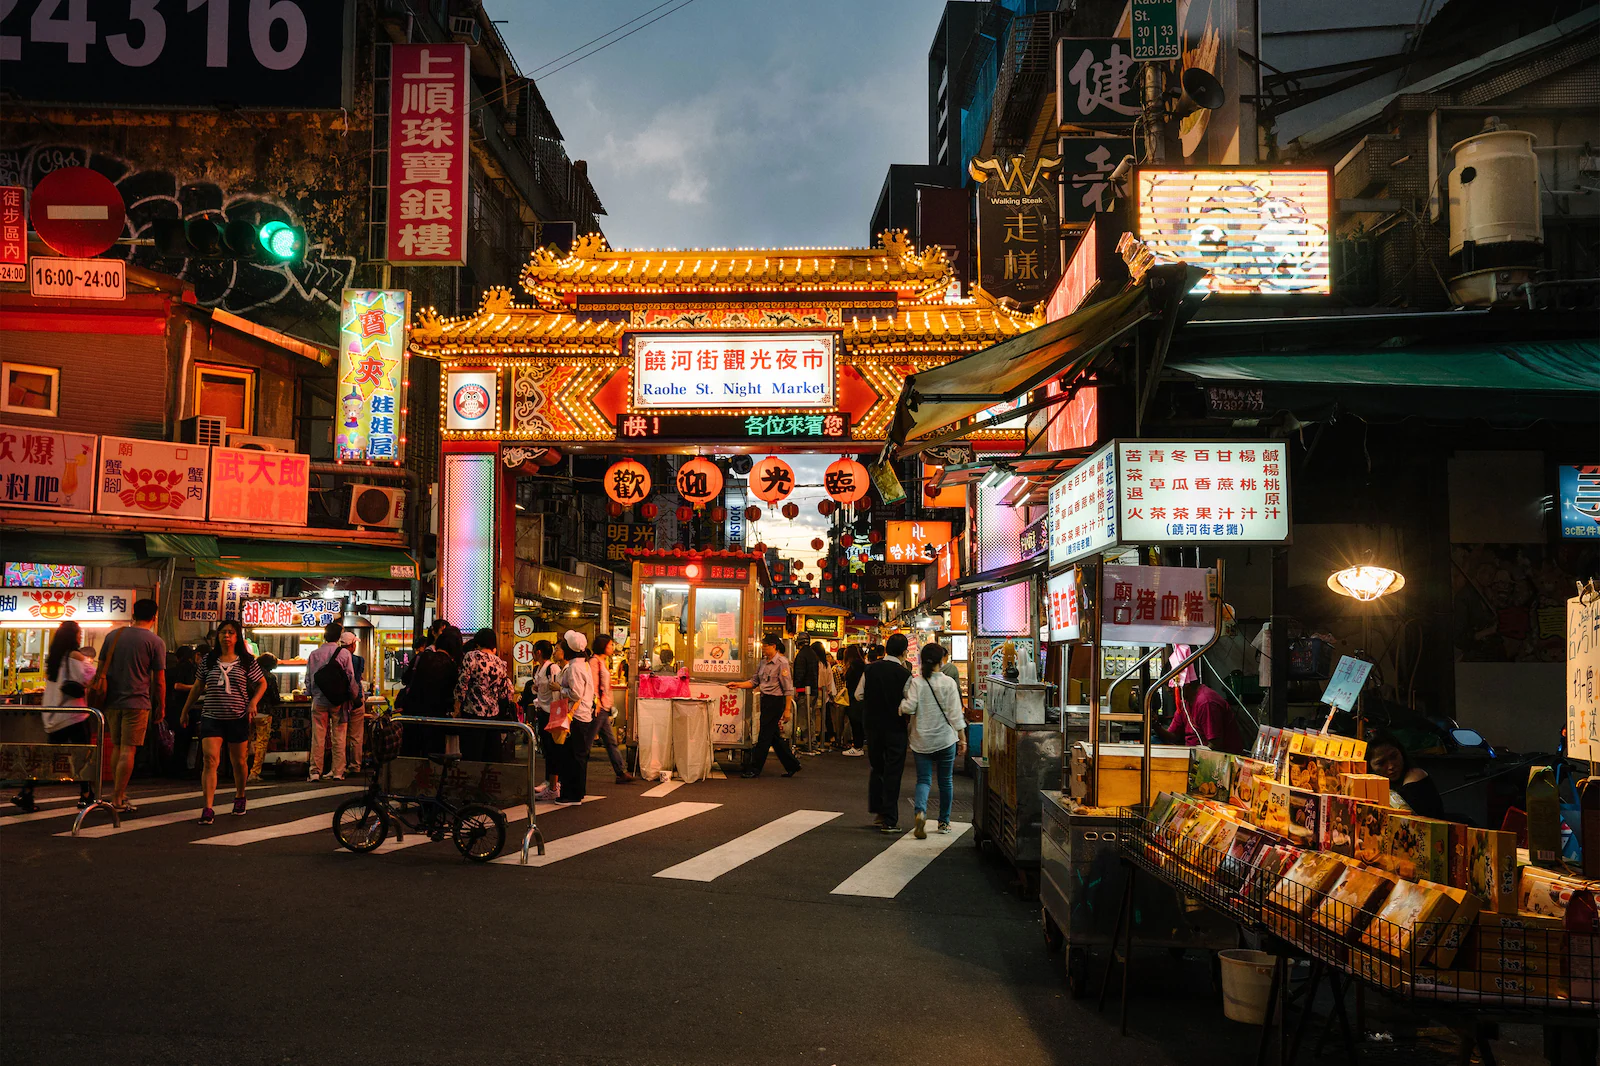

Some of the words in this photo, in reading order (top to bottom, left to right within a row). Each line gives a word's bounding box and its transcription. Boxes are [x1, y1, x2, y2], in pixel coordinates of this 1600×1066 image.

[1134, 10, 1150, 21] St.
[1138, 26, 1150, 37] 30
[1161, 25, 1173, 36] 33
[1135, 46, 1154, 56] 226
[1159, 45, 1177, 55] 255
[1069, 43, 1143, 116] 健
[398, 49, 455, 256] 上順珠寶銀樓
[3, 190, 20, 259] 徒步區內
[1003, 213, 1039, 279] 走樣
[0, 267, 24, 279] 24:00
[36, 268, 120, 288] 16:00~24:00
[644, 349, 825, 371] 饒河街觀光夜市
[643, 383, 687, 395] Raohe
[696, 383, 714, 395] St.
[723, 383, 762, 397] Night
[772, 382, 825, 394] Market
[369, 395, 394, 456] 娃娃屋
[104, 459, 122, 494] 蟹腳
[216, 452, 305, 487] 武大郎
[613, 468, 645, 499] 歡
[679, 470, 711, 497] 迎
[762, 466, 791, 494] 光
[825, 470, 856, 494] 臨
[1125, 449, 1144, 520] 苦茶退火
[1148, 449, 1167, 520] 青草茶
[1171, 449, 1189, 520] 冬瓜茶
[1193, 449, 1212, 520] 百香果
[1216, 449, 1235, 520] 甘蔗汁
[1239, 449, 1257, 520] 楊桃汁
[0, 473, 59, 503] 料吧
[214, 486, 305, 520] 胡椒餅
[730, 505, 741, 544] ENSTOCK
[607, 544, 642, 561] 銀
[244, 601, 293, 625] 胡椒餅
[296, 600, 340, 612] 不好吃
[302, 613, 334, 626] 免費
[712, 723, 736, 734] 733
